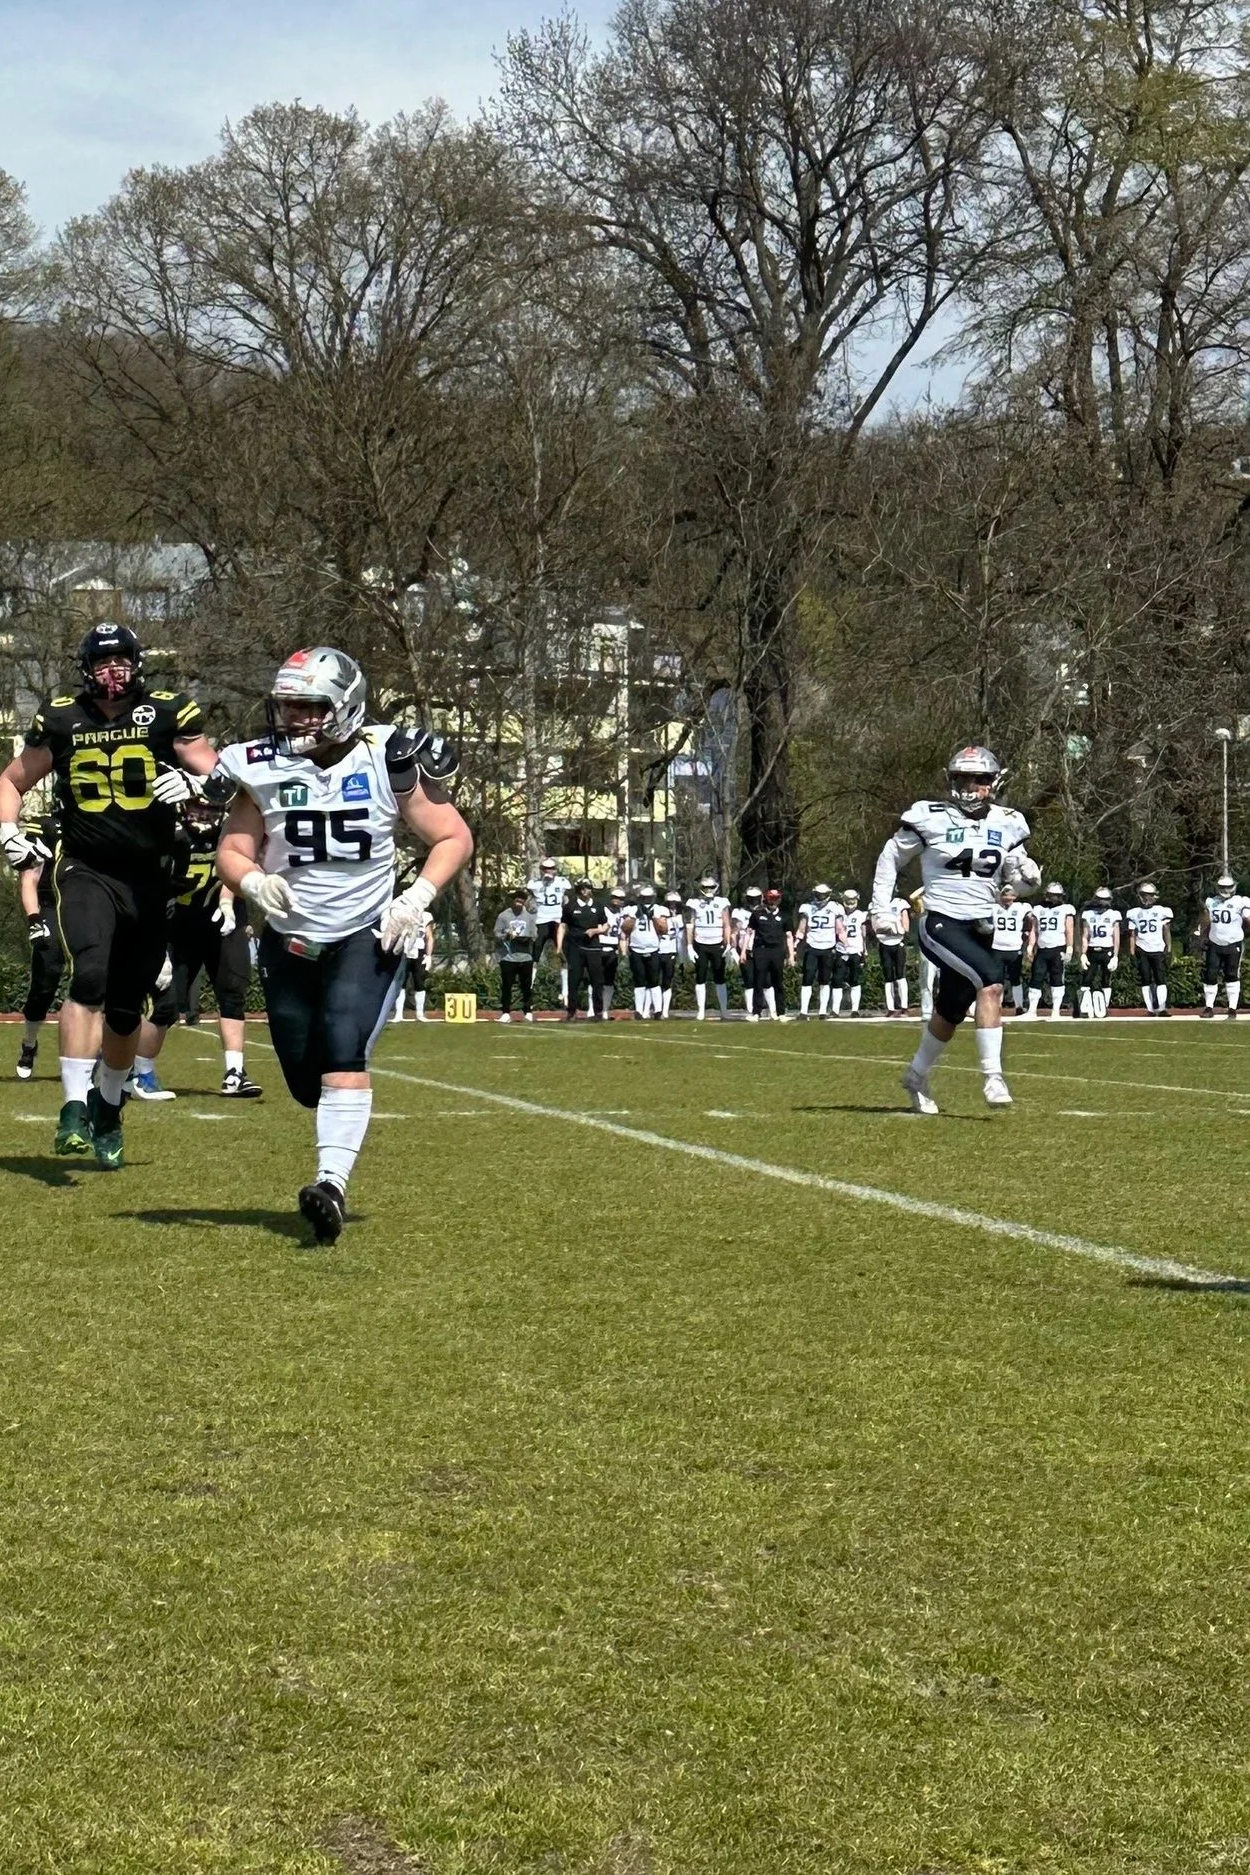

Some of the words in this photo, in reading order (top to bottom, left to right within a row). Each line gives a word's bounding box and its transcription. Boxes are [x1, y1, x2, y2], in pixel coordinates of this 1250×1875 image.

[72, 727, 149, 746] PRAGUE
[70, 745, 157, 812] 60
[285, 808, 371, 867] 95
[706, 911, 714, 924] 11
[997, 917, 1017, 931] 93
[447, 997, 471, 1018] 30
